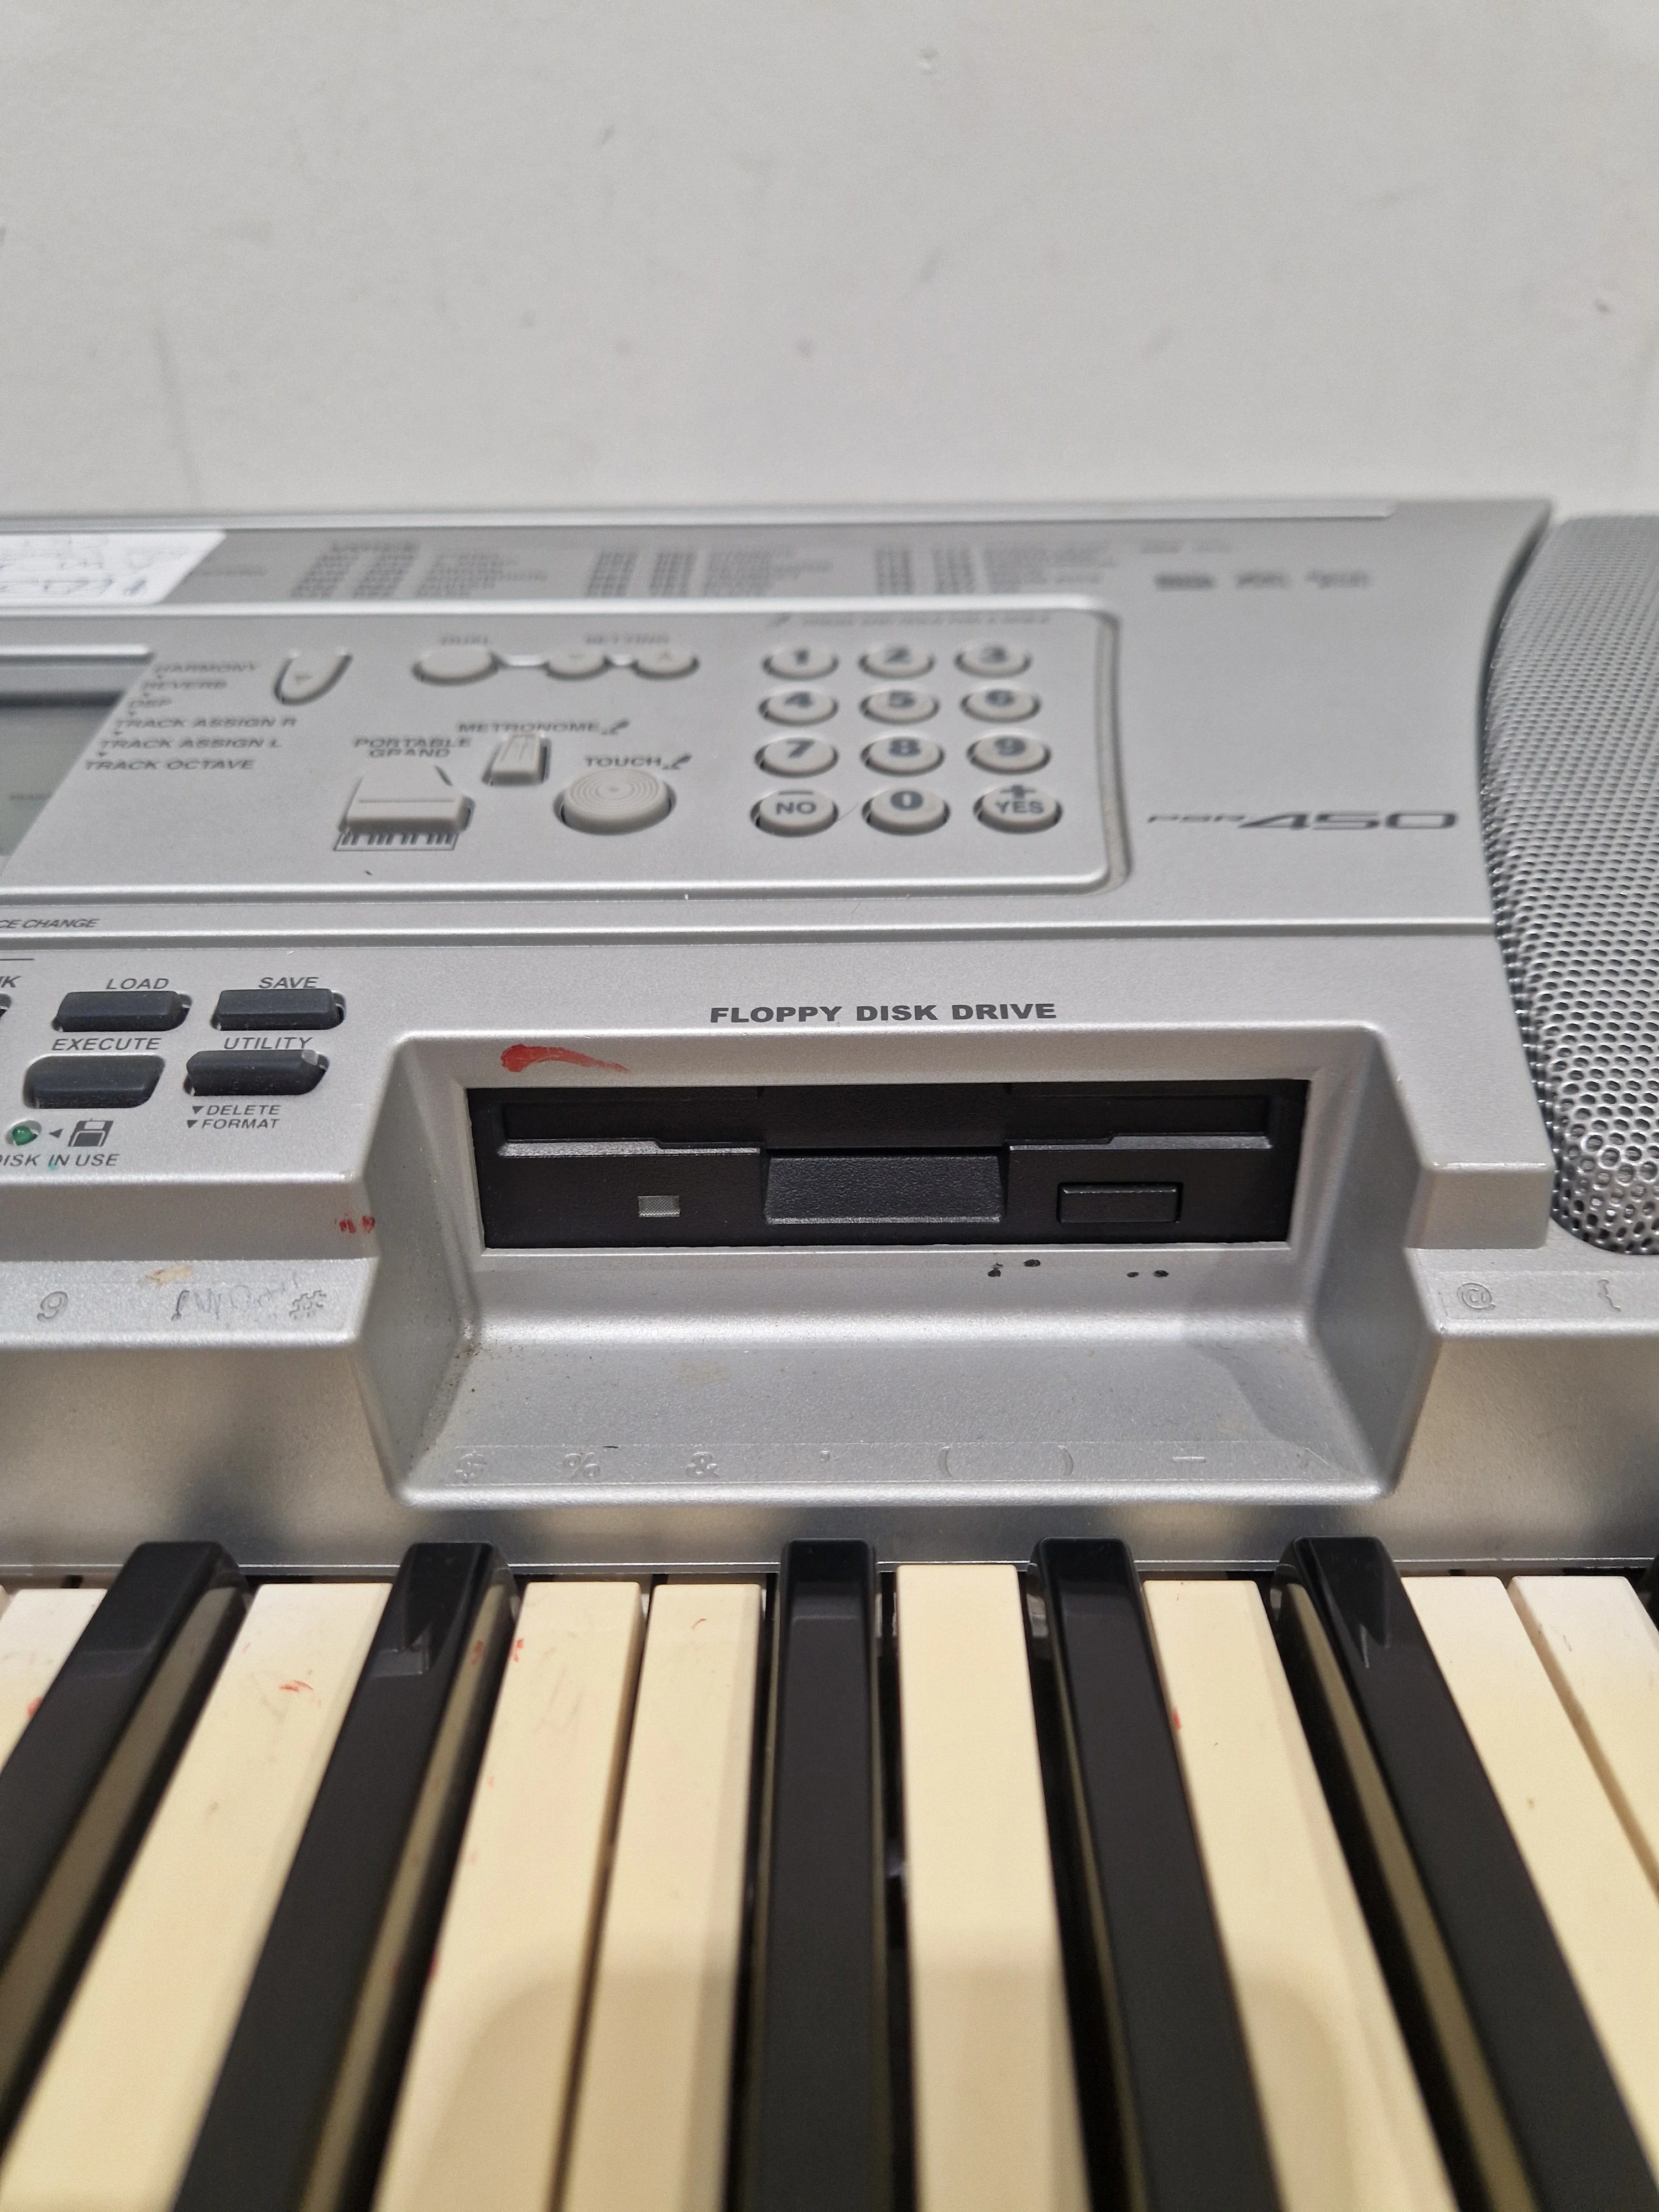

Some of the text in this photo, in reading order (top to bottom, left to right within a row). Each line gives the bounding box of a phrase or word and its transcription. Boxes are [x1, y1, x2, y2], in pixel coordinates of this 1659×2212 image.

[794, 645, 810, 665] 1
[783, 691, 814, 708] 4
[888, 690, 916, 708] 5
[114, 718, 297, 729] TRACK ASSIGN R
[457, 722, 600, 733] METRONOME
[100, 738, 283, 749] TRACK ASSIGN L
[353, 737, 472, 748] PORTABLE
[888, 737, 921, 758] 8
[994, 736, 1027, 757] 9
[368, 748, 450, 758] GRAND
[786, 740, 816, 759] 7
[85, 759, 256, 770] TRACK OCTAVE
[583, 755, 662, 767] TOUCH
[890, 789, 924, 811] 0
[776, 801, 817, 815] NO
[995, 801, 1044, 815] YES
[23, 919, 101, 928] CHANGE
[106, 978, 169, 990] LOAD
[258, 976, 320, 989] SAVE
[709, 1003, 1057, 1023] FLOPPY DISK DRIVE
[51, 1037, 162, 1051] EXECUTE
[223, 1036, 314, 1050] UTILITY
[206, 1105, 281, 1115] DELETE
[201, 1118, 281, 1129] FORMAT
[0, 1154, 121, 1167] ISK IN USE
